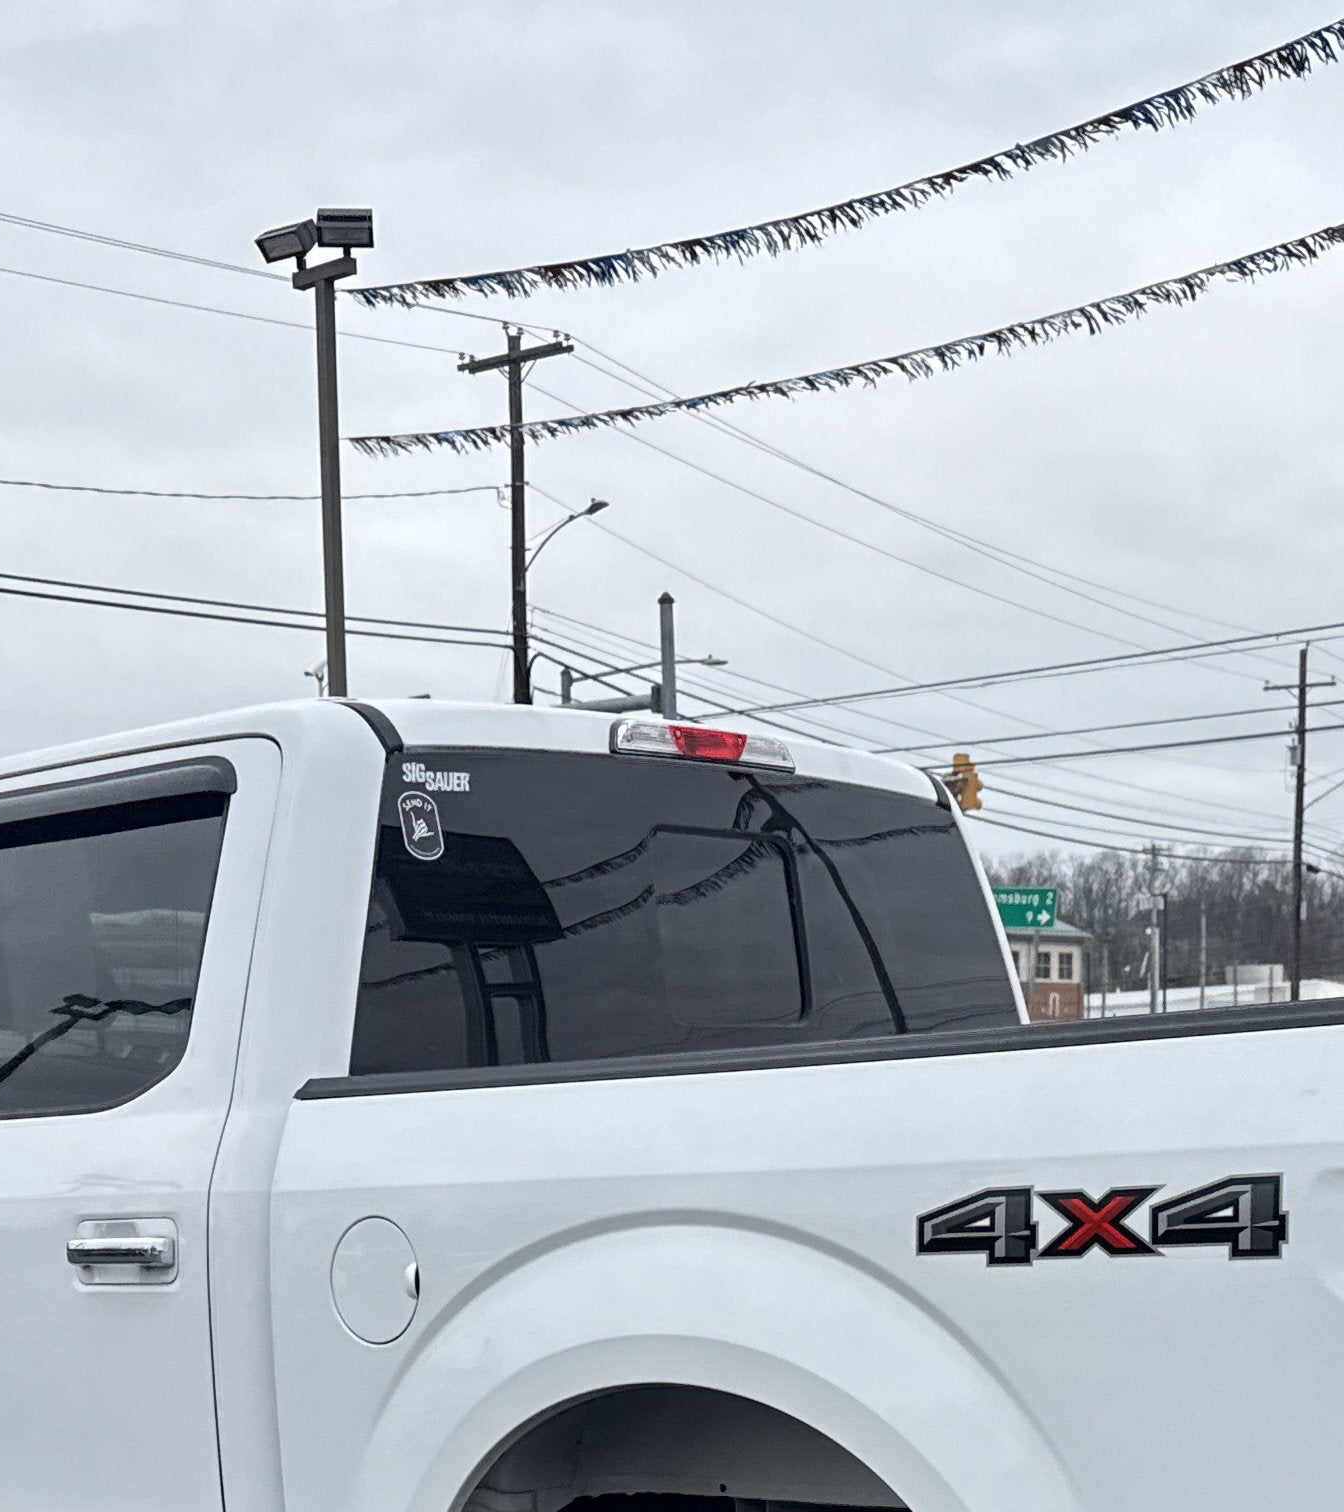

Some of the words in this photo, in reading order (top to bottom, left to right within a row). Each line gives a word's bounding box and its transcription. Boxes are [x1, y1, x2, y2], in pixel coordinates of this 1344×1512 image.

[402, 762, 426, 783] SIG
[425, 771, 470, 791] SAUER
[1045, 891, 1053, 905] 2
